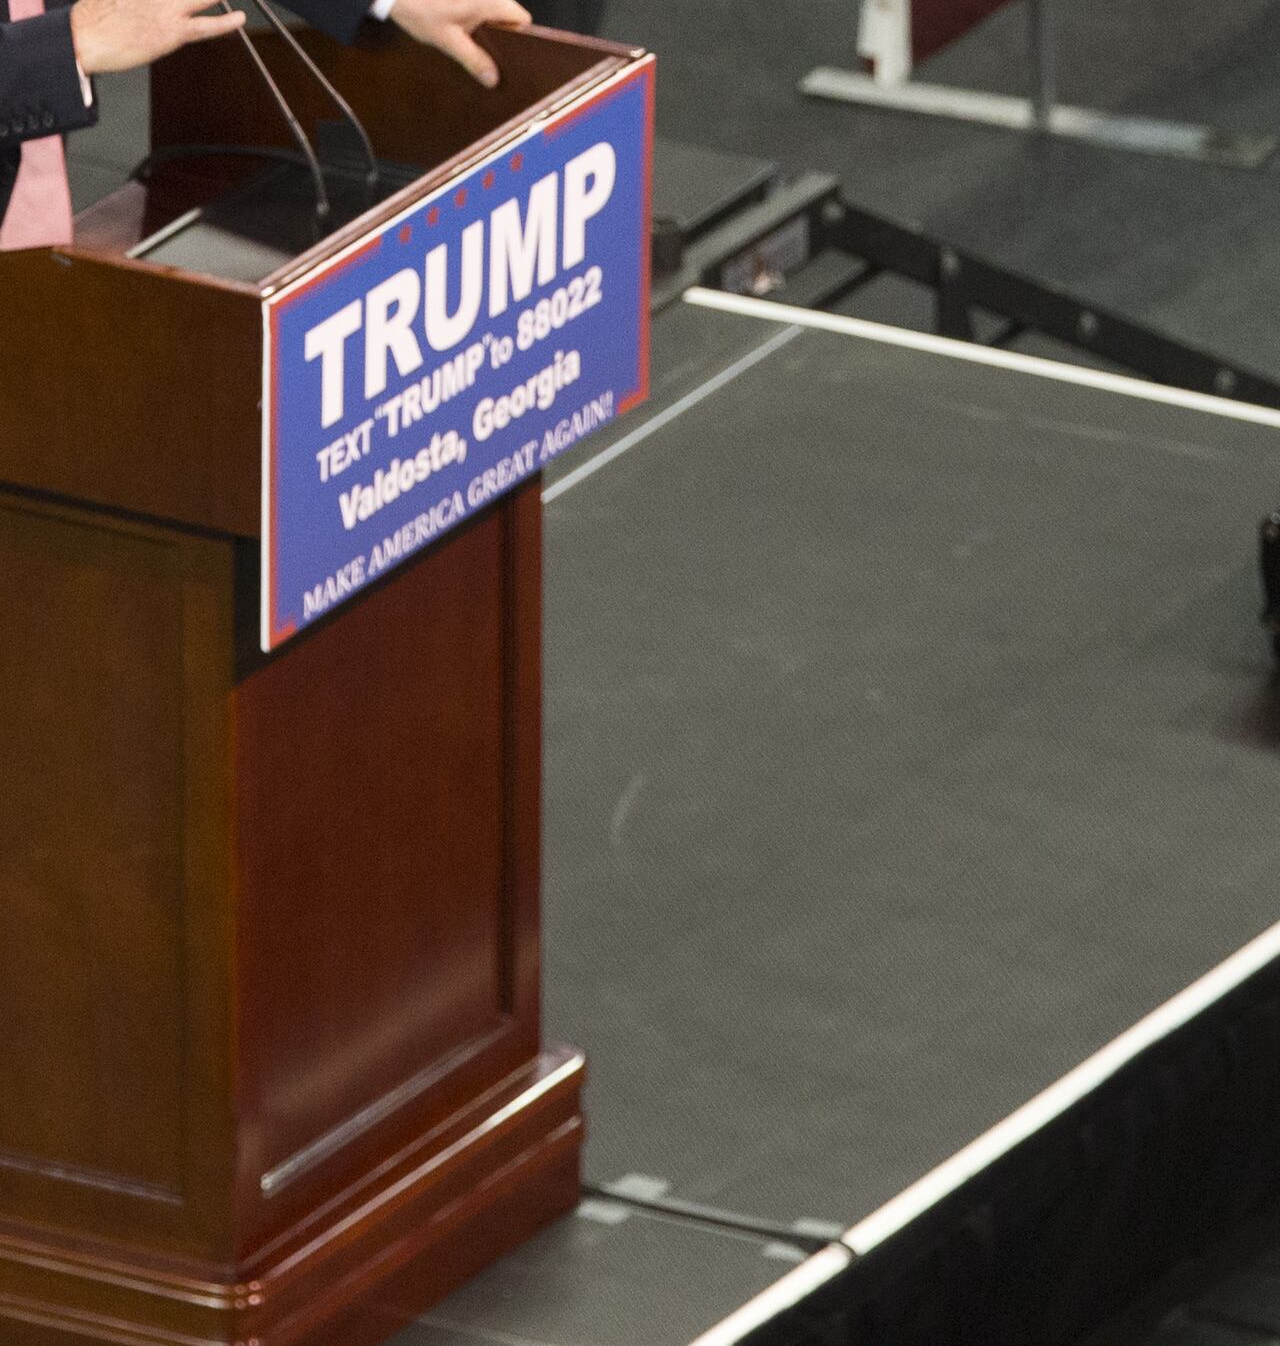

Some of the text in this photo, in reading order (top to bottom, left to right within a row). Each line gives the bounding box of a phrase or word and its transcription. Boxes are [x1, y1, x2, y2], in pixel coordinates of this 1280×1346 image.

[304, 140, 617, 430] TRUMP
[316, 417, 375, 483] TEXT
[516, 264, 603, 351] 88022
[303, 389, 614, 620] MAKE AMERICA GREAT AGAIN!
[338, 349, 581, 531] Valdosta, Georgia
